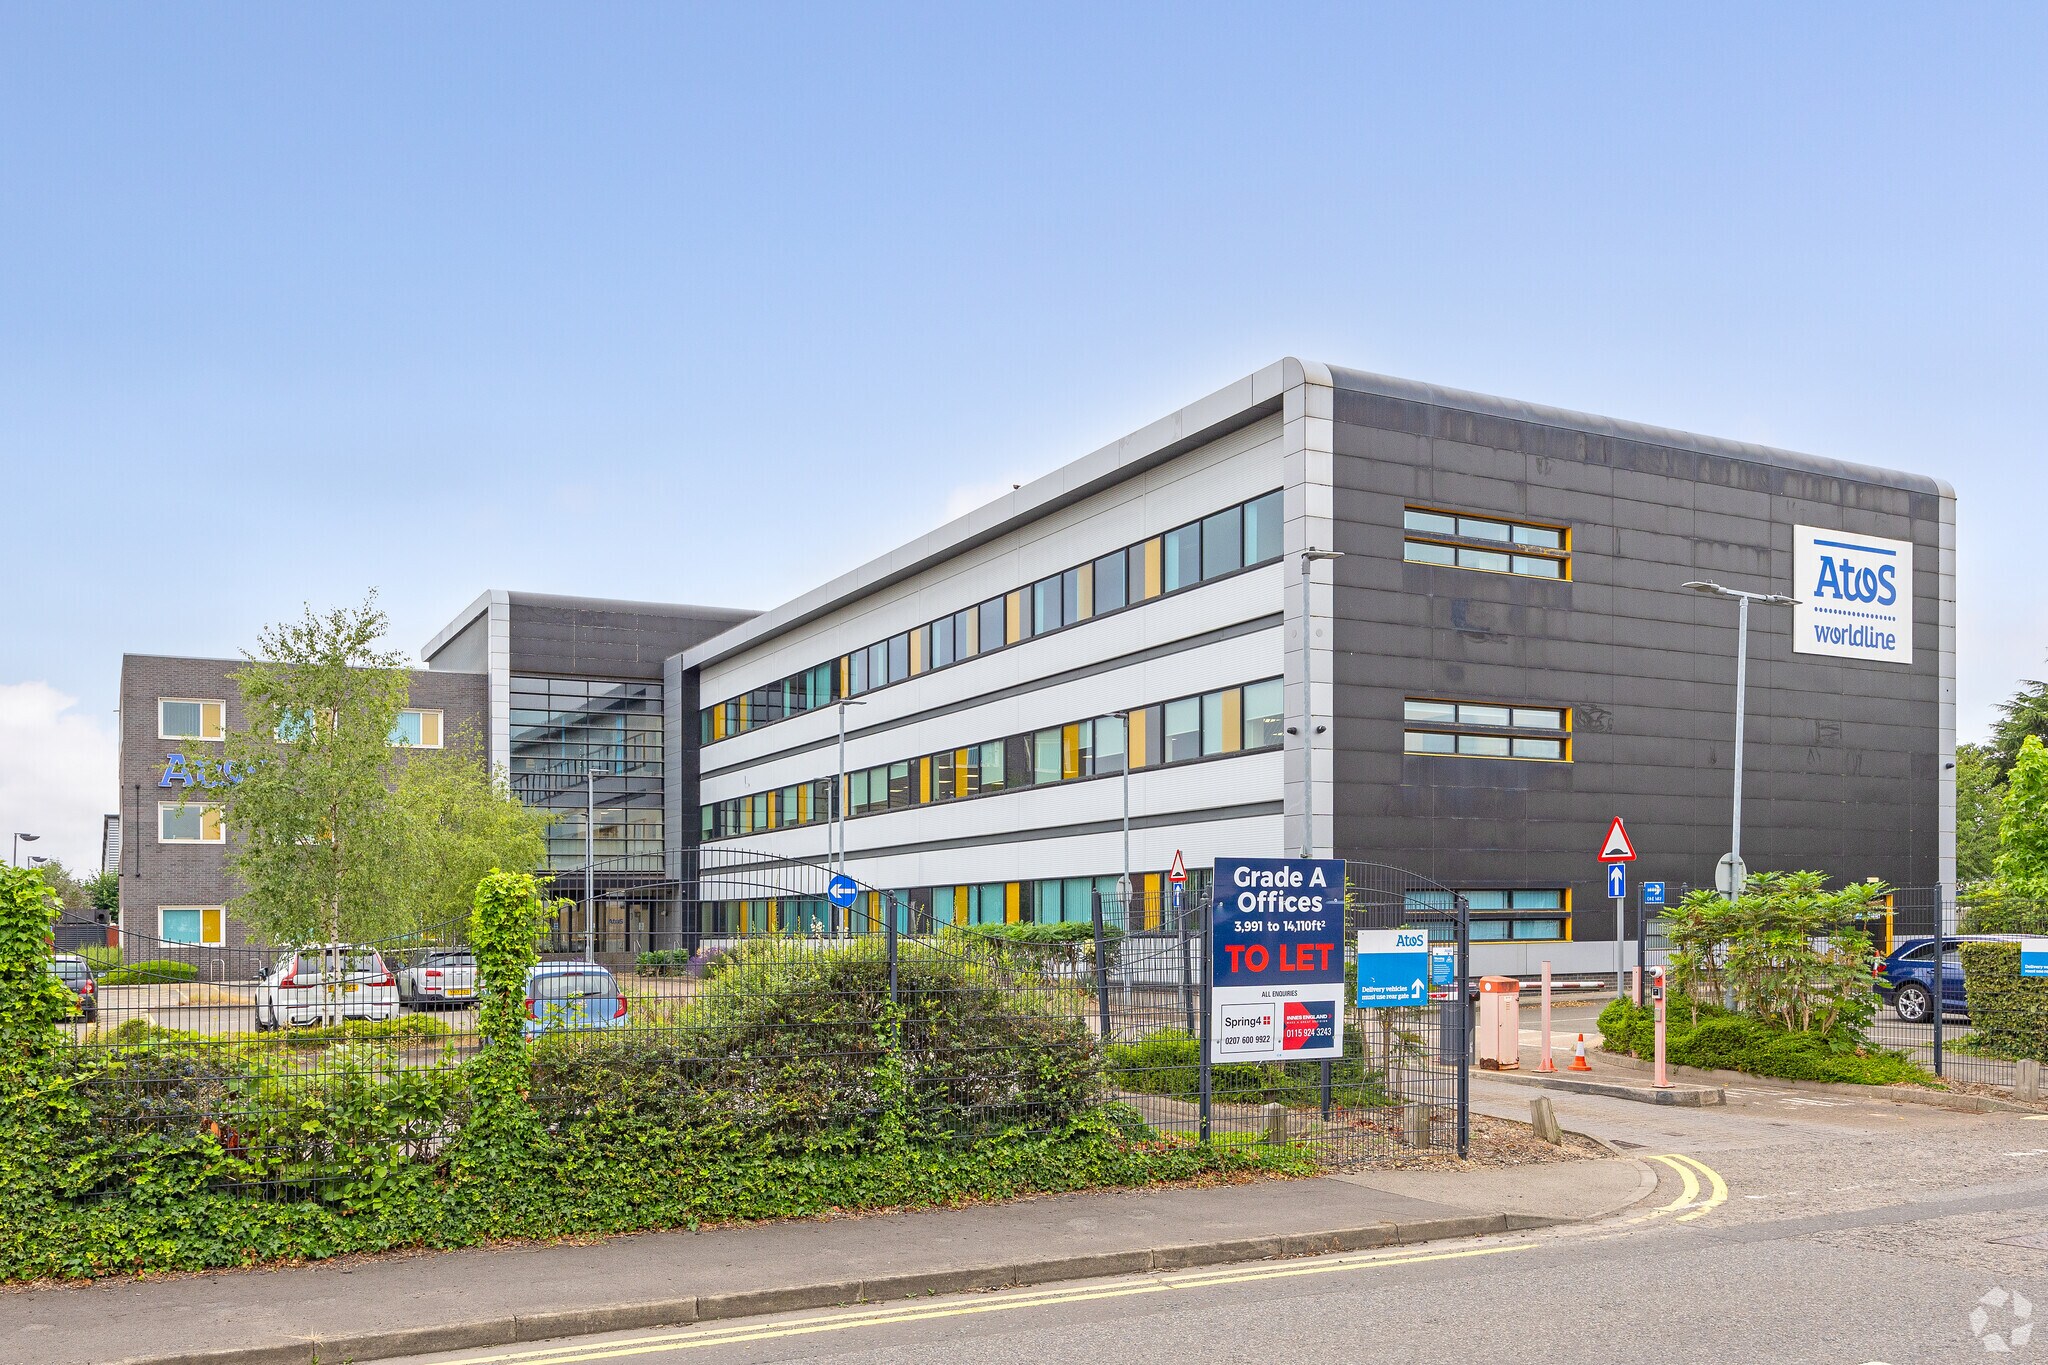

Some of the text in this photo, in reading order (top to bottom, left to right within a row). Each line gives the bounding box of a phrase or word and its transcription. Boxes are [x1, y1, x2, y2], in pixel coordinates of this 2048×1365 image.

[1814, 624, 1895, 651] worldline
[1233, 866, 1327, 888] Grade A
[1237, 890, 1323, 913] Offices
[1234, 920, 1263, 933] 3,991
[1267, 921, 1280, 931] to
[1225, 943, 1334, 972] TO LET
[1225, 1016, 1261, 1028] Spring4
[1286, 1028, 1331, 1038] 0115 924 3243
